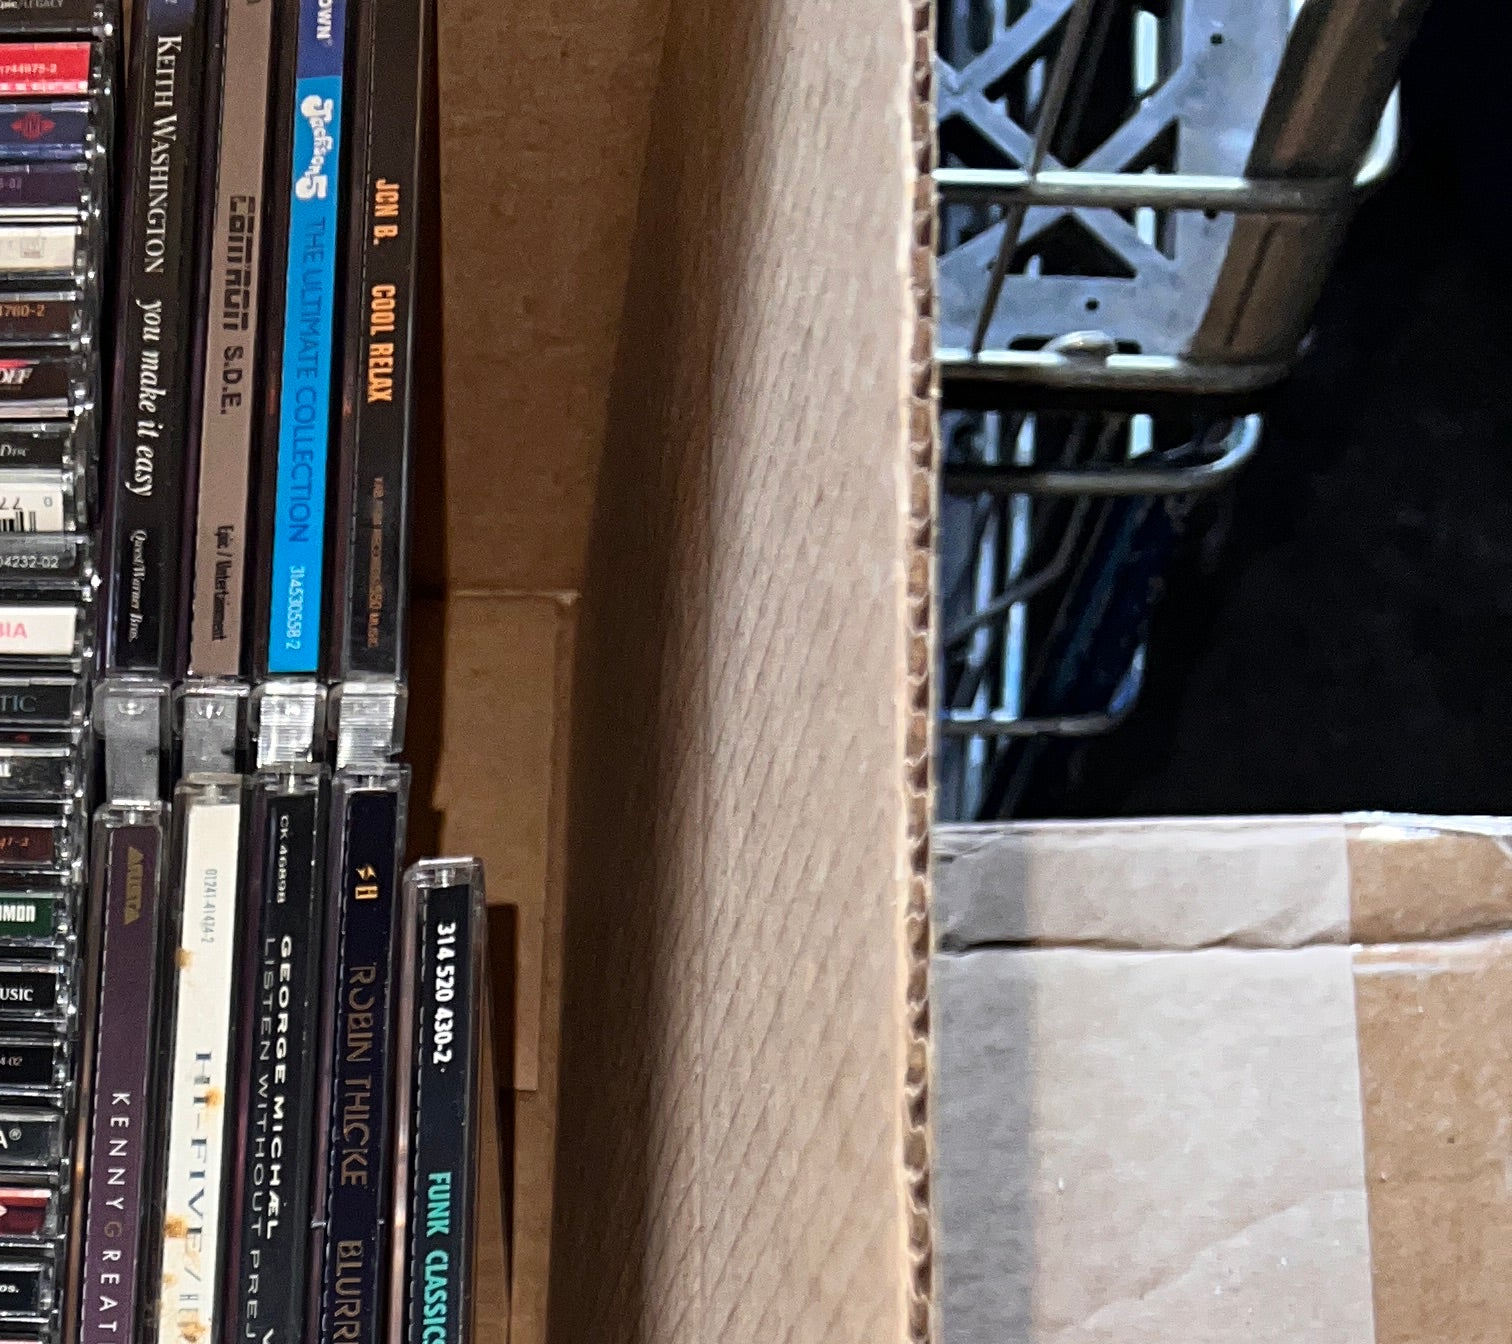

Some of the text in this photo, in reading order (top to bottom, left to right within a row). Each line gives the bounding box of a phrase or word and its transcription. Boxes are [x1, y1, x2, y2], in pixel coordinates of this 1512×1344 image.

[144, 35, 182, 273] KEITH WASHINGTON
[368, 284, 395, 403] COOL RELAX
[274, 935, 292, 1084] GEORGE
[426, 1171, 452, 1236] FUNK
